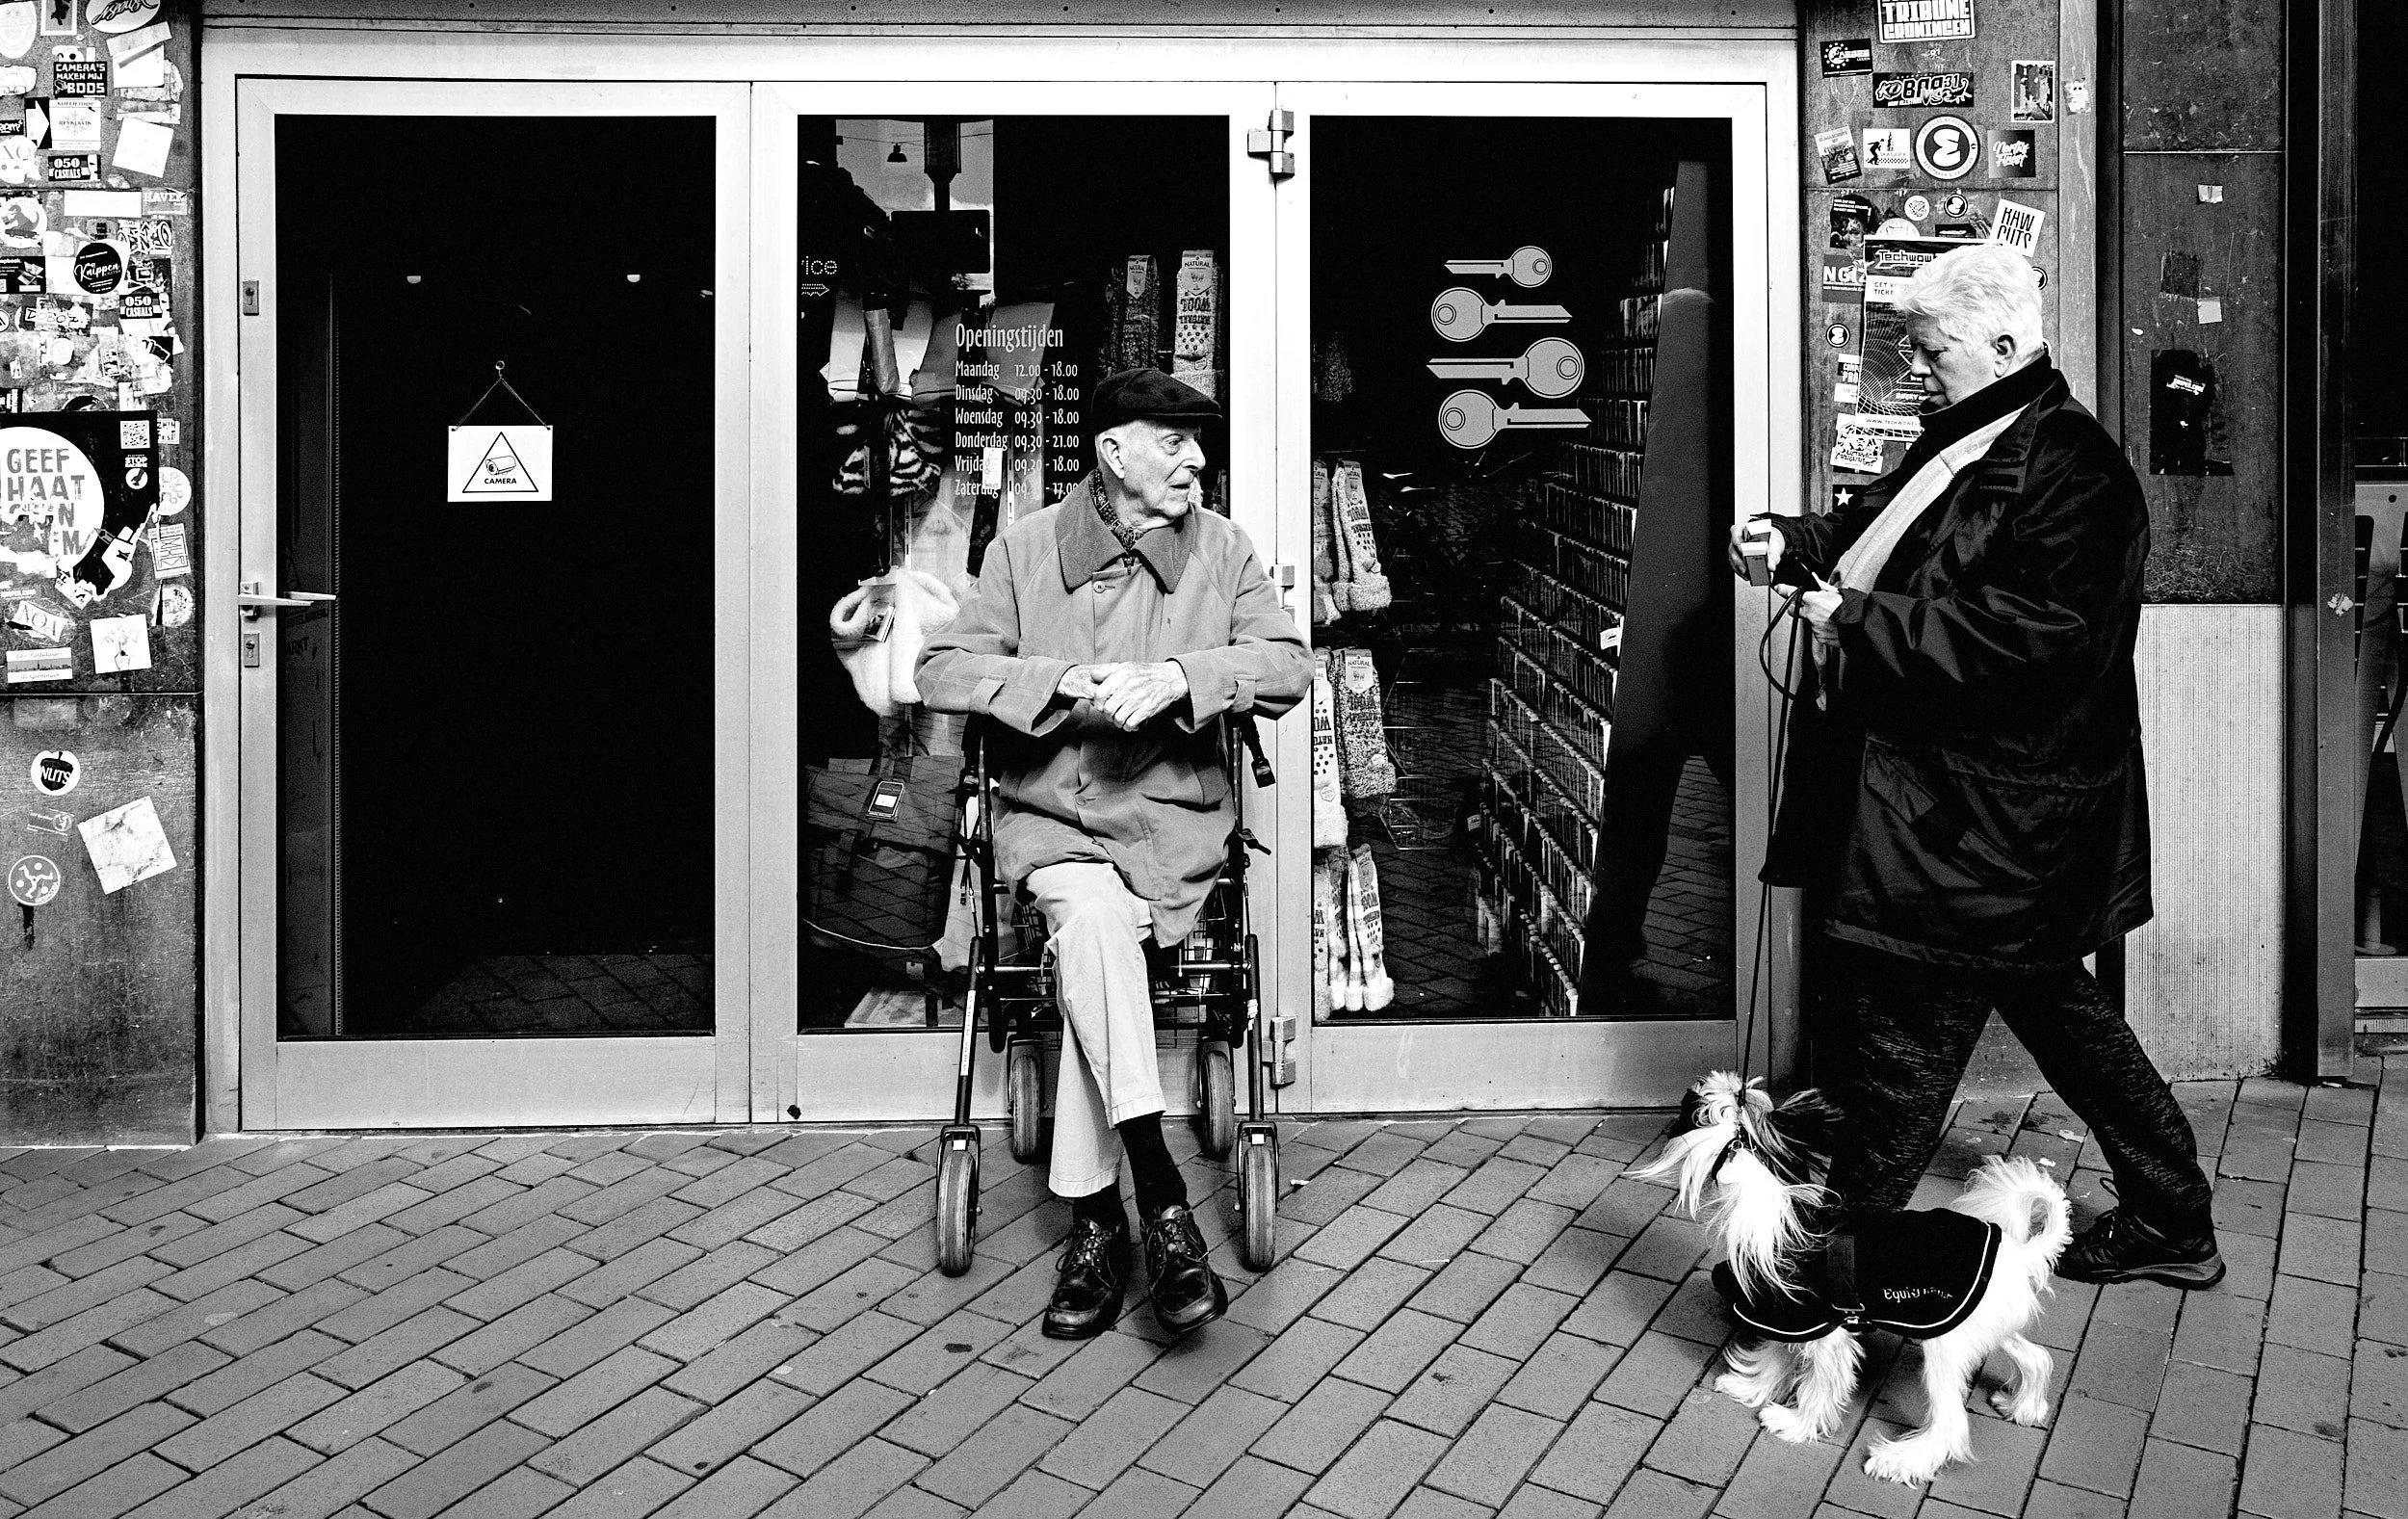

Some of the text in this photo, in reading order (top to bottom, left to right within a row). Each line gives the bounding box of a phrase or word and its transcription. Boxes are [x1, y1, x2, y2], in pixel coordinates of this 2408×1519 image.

[1882, 0, 1971, 23] TRIBUNE
[55, 63, 106, 72] CAMERA'S
[66, 82, 106, 94] BOOS
[53, 157, 81, 169] 050
[800, 255, 838, 275] ice
[1183, 260, 1211, 269] NATURAL
[124, 296, 152, 307] 050
[955, 323, 1063, 353] Openingstijden
[955, 360, 1000, 380] Maandag
[1014, 364, 1041, 377] 12.00
[1051, 361, 1078, 377] 18.00
[955, 384, 994, 404] Dinsdag
[1014, 387, 1043, 405] 09.30
[1052, 384, 1080, 400] 18.00
[955, 407, 1004, 428] Woensdag
[1014, 411, 1043, 429] 09.30
[1052, 408, 1080, 424] 18.00
[955, 432, 1008, 451] Donderdag
[1014, 435, 1043, 453] 09.30
[1052, 435, 1080, 448] 21.00
[7, 448, 70, 473] GEEF
[1014, 458, 1043, 476] 09.30
[1052, 456, 1080, 471] 18.00
[7, 474, 86, 501] HAAT
[1348, 658, 1371, 667] NATURAL
[39, 764, 71, 785] NUTS
